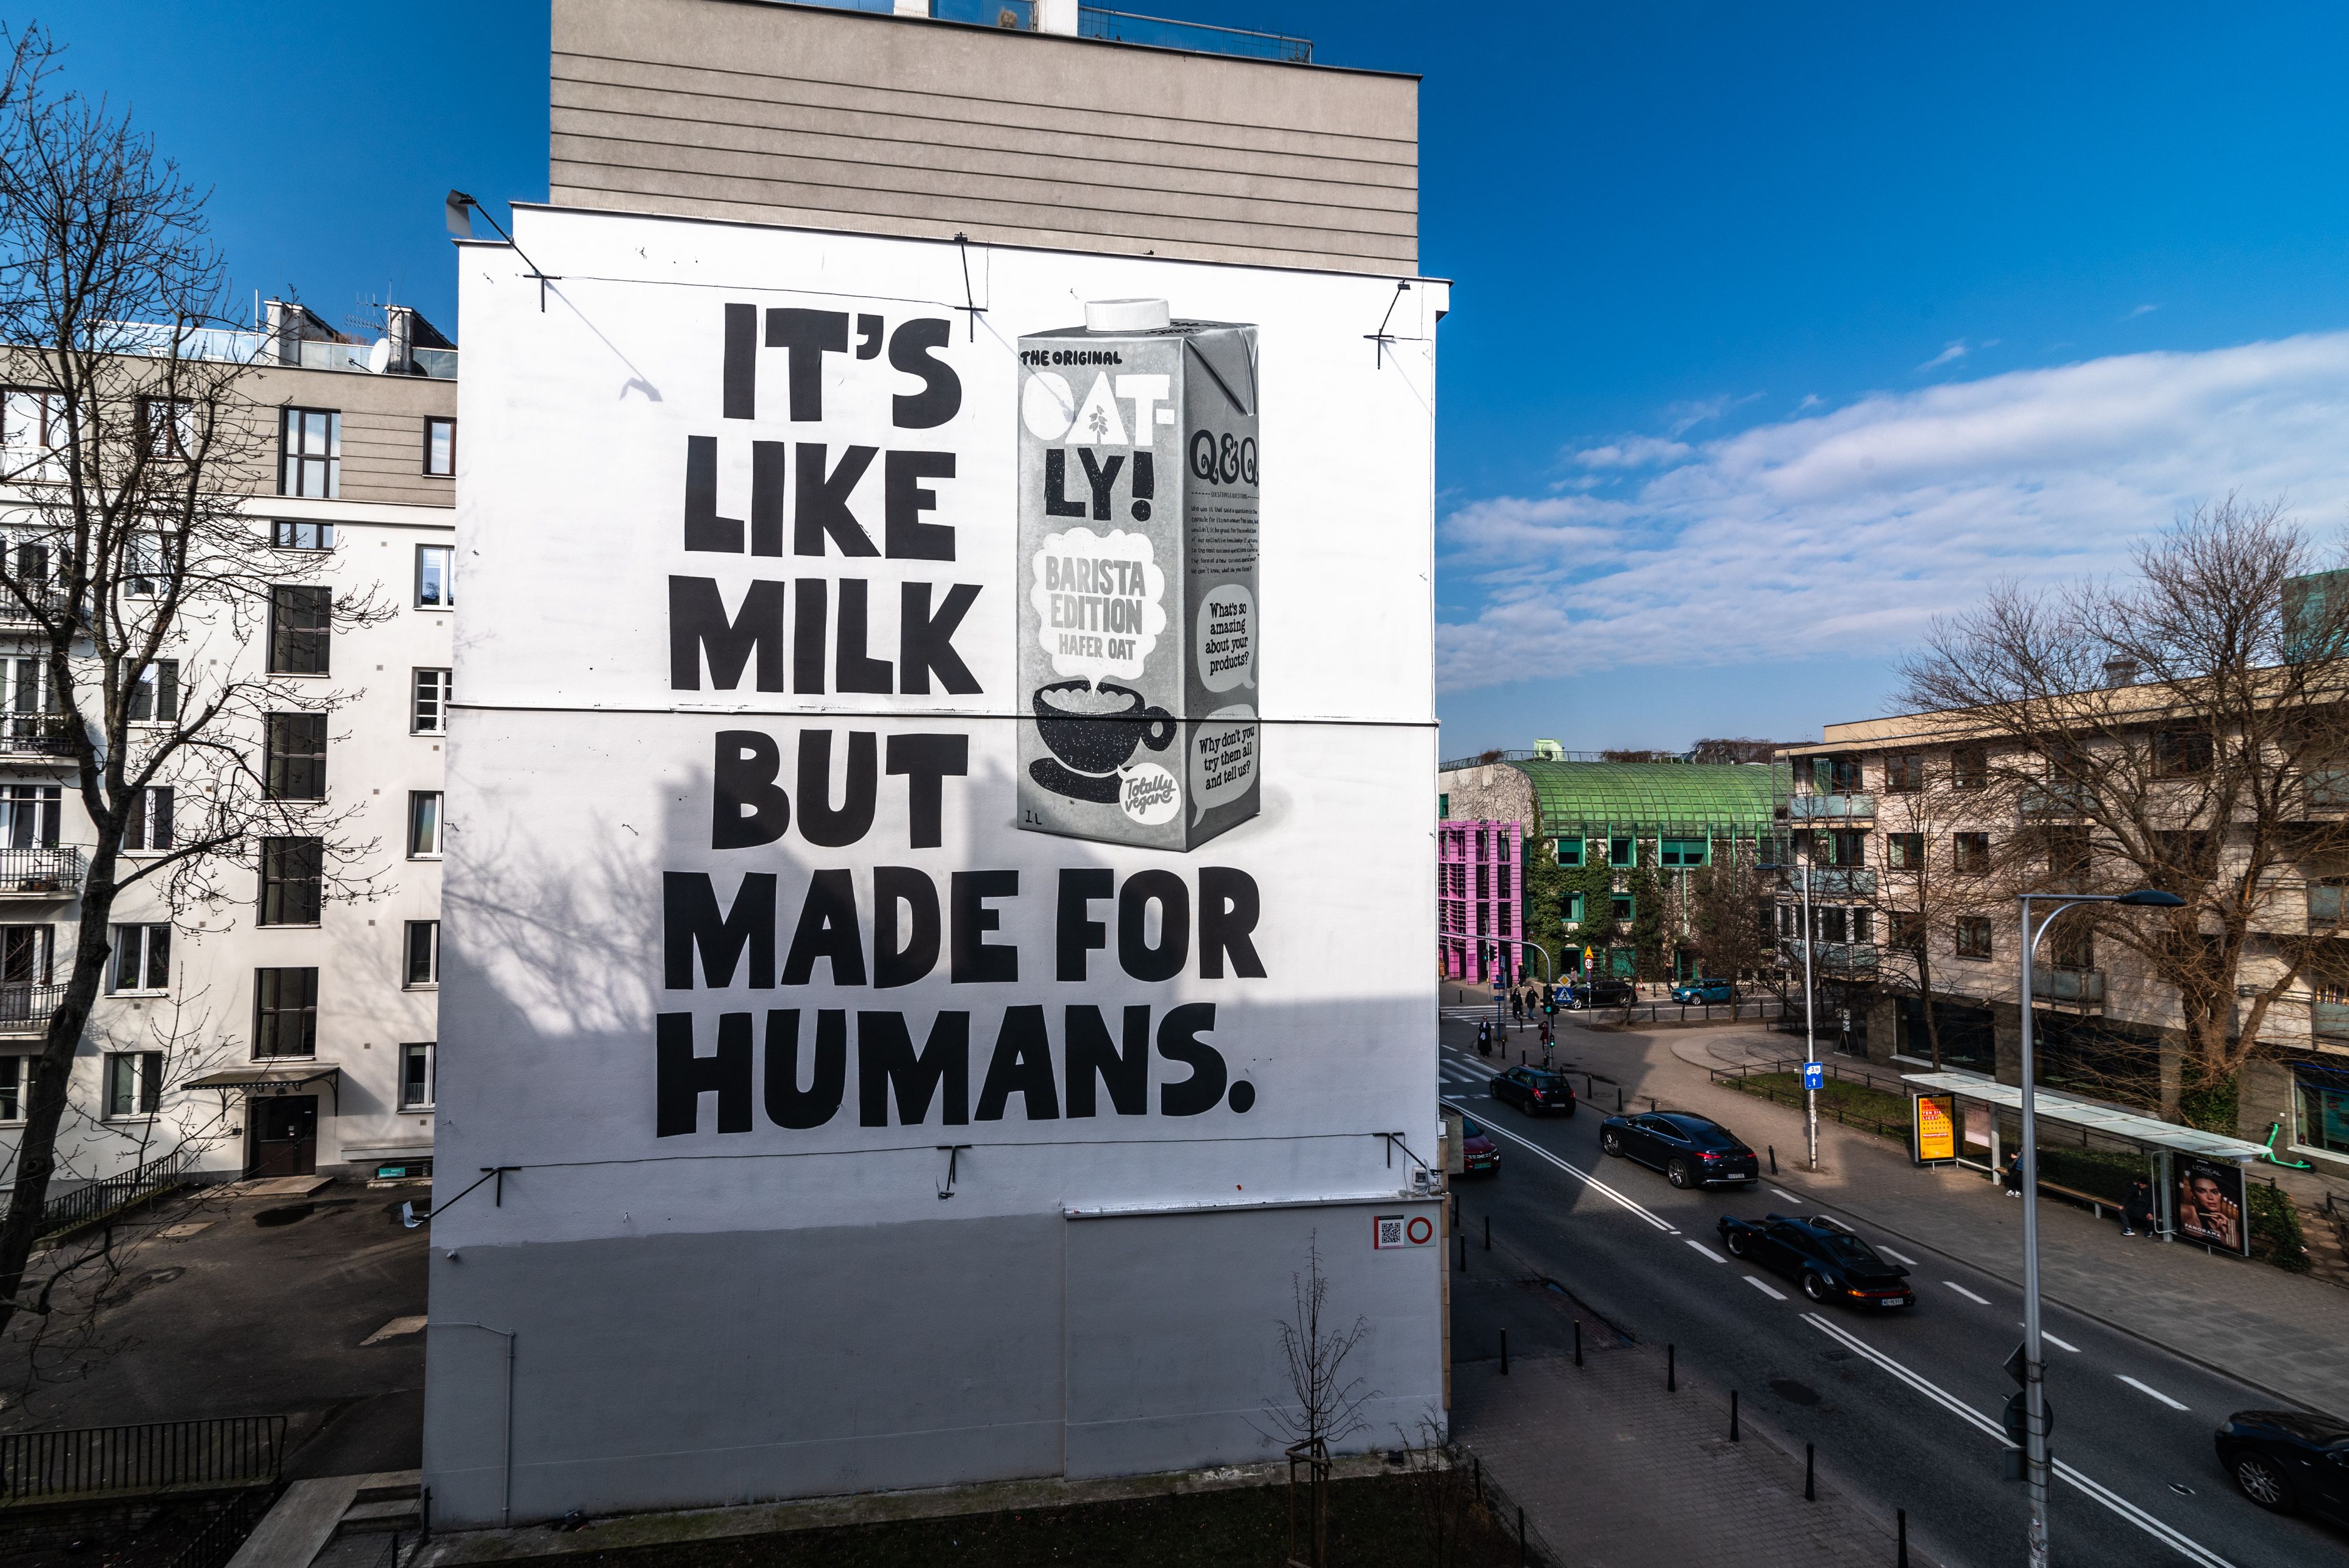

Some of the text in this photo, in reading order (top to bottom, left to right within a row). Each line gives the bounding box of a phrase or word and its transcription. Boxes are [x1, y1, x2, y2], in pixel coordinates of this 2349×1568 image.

[723, 303, 962, 429] IT'S
[1020, 350, 1122, 366] THE ORIGINAL
[684, 435, 956, 562] LIKE
[1045, 448, 1155, 522] LY!
[1045, 555, 1146, 597] BARISTA
[1050, 594, 1142, 635] EDITION
[1209, 602, 1247, 619] What's so
[668, 575, 984, 695] MILK
[1210, 618, 1246, 635] amazing
[1058, 635, 1136, 660] HAFER OAT
[1205, 637, 1248, 654] about your
[1210, 651, 1249, 676] products?
[1199, 726, 1254, 754] Why don't you
[1204, 741, 1252, 773] try them all
[712, 729, 968, 849] BUT
[1125, 774, 1176, 799] Totally
[1205, 760, 1251, 790] and tell us?
[1125, 792, 1172, 815] vegan
[663, 866, 1267, 989] MADE FOR
[656, 1002, 1256, 1138] HUMANS.
[2184, 1223, 2221, 1238] PANORAMA
